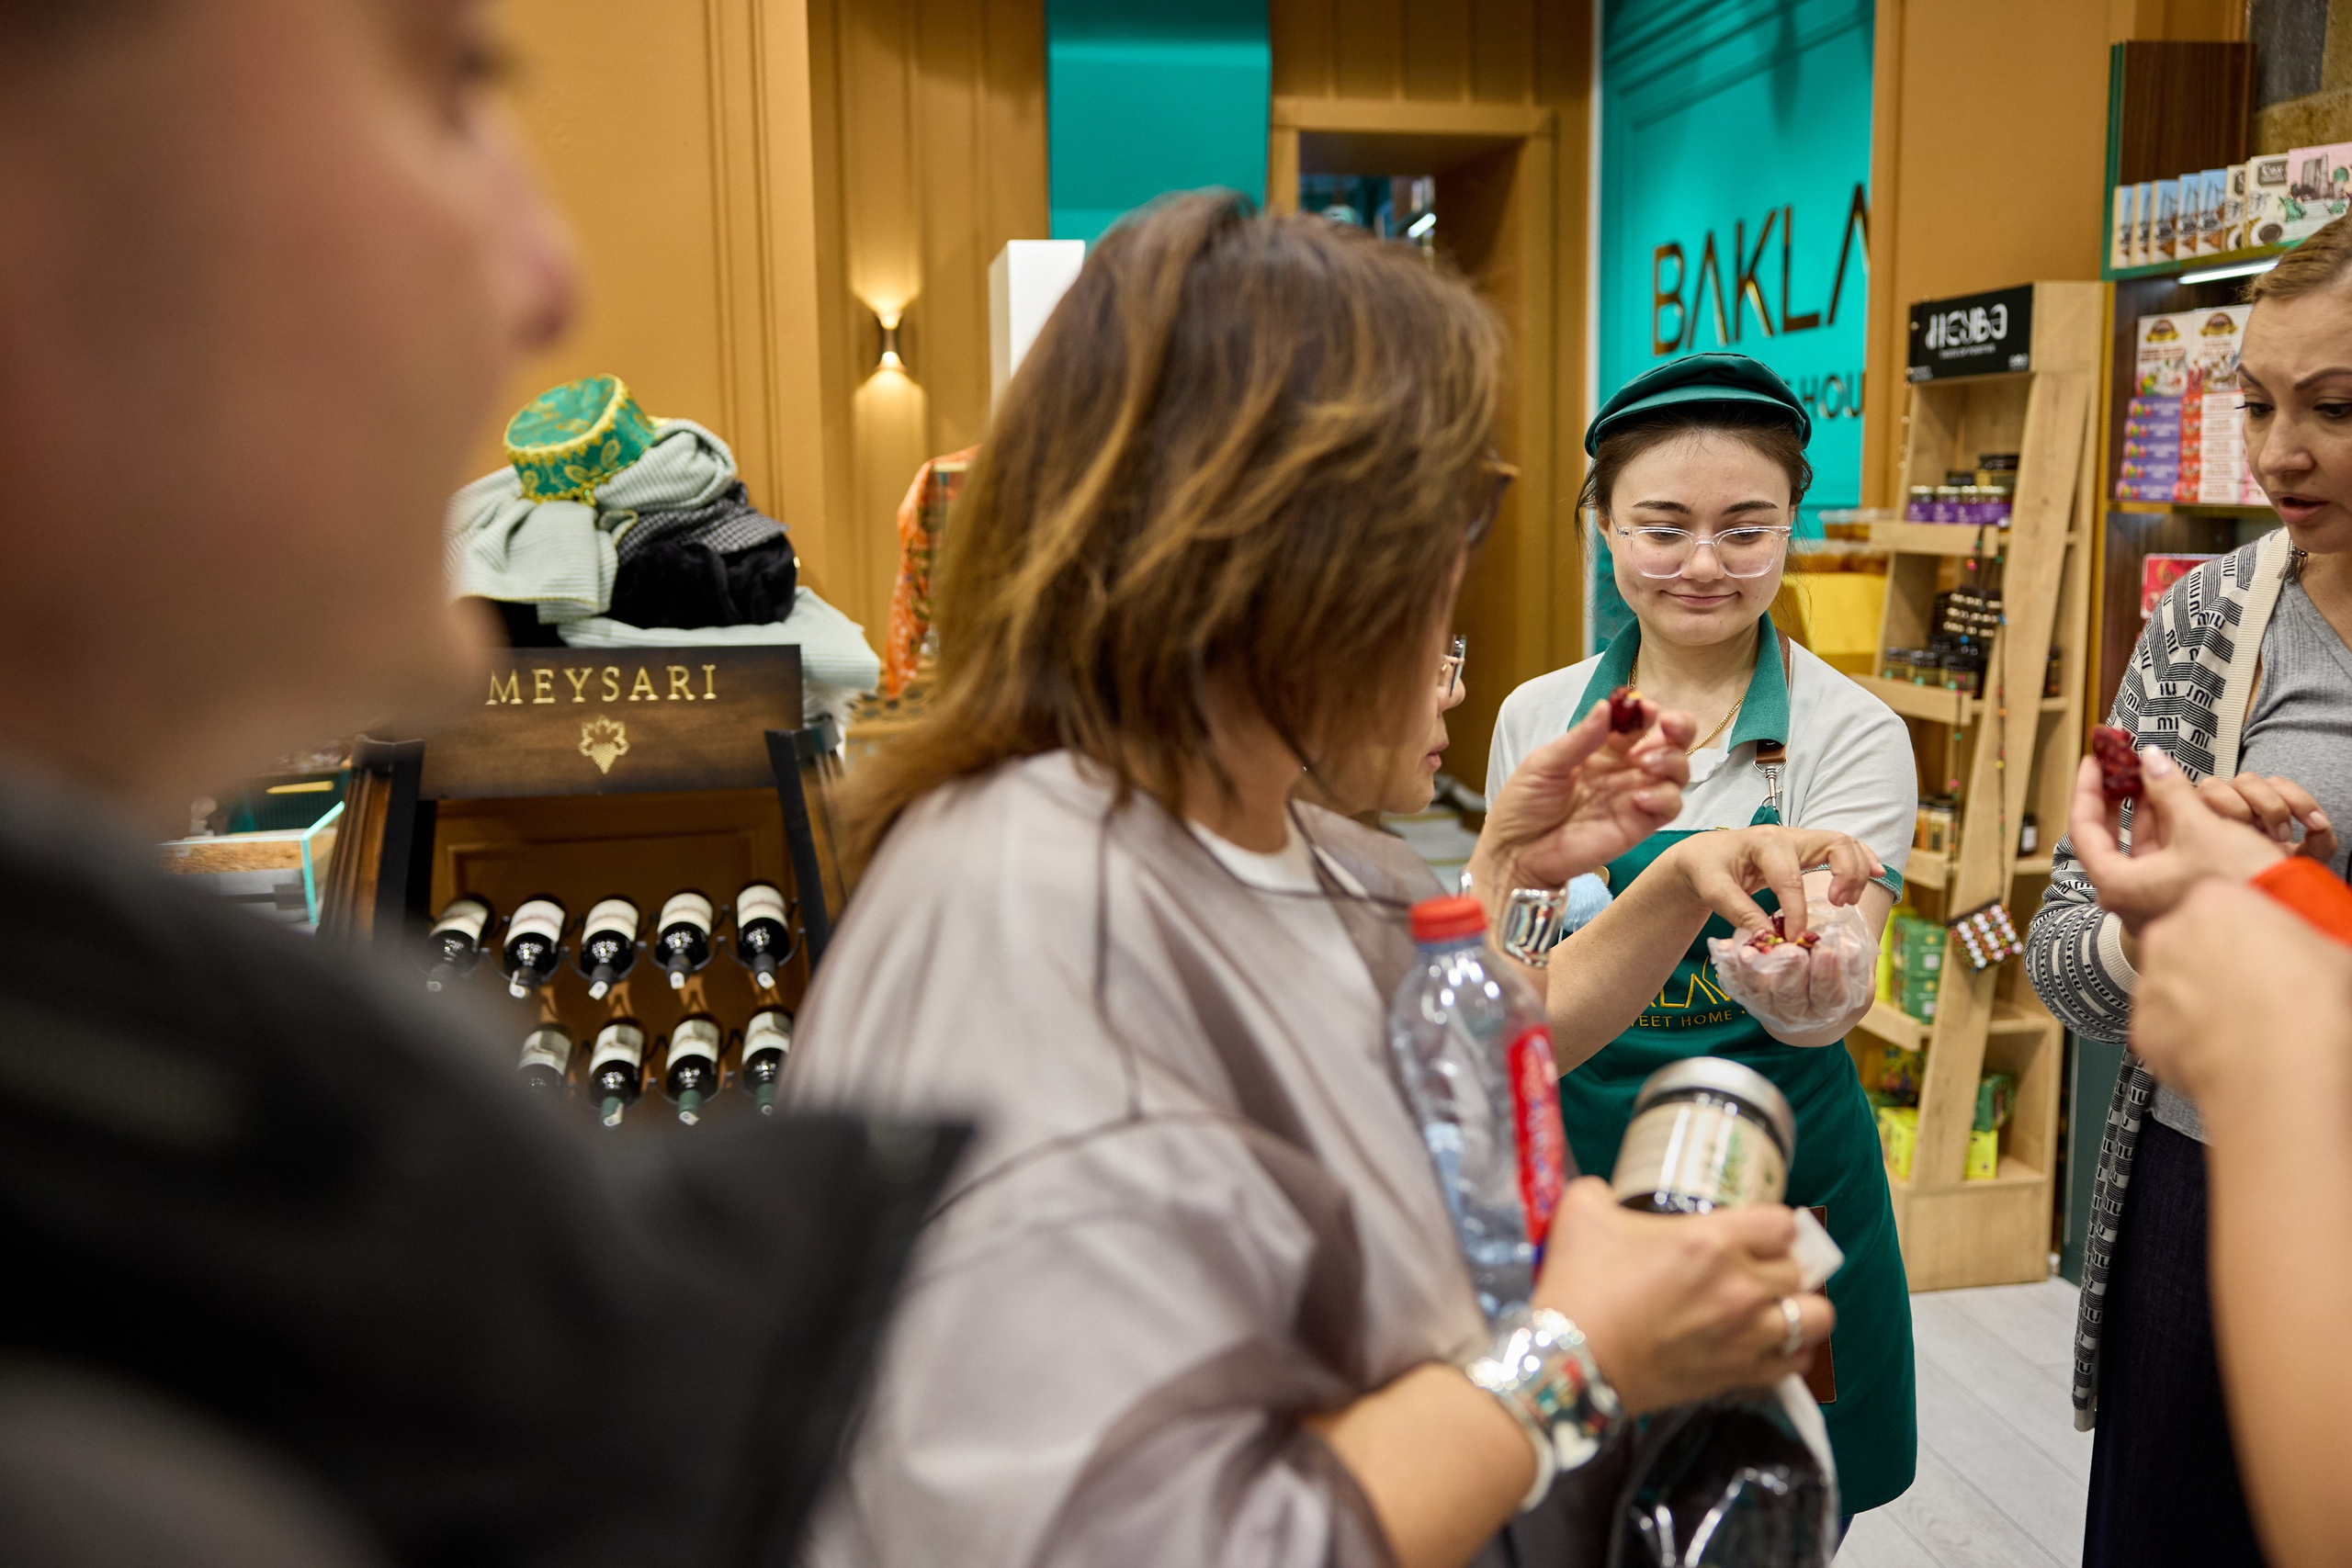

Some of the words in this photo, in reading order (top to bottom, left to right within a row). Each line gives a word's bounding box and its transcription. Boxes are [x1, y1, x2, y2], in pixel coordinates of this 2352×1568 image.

[485, 664, 717, 705] MEYSARI
[1631, 1015, 1672, 1028] EET
[1680, 1010, 1733, 1028] HOME
